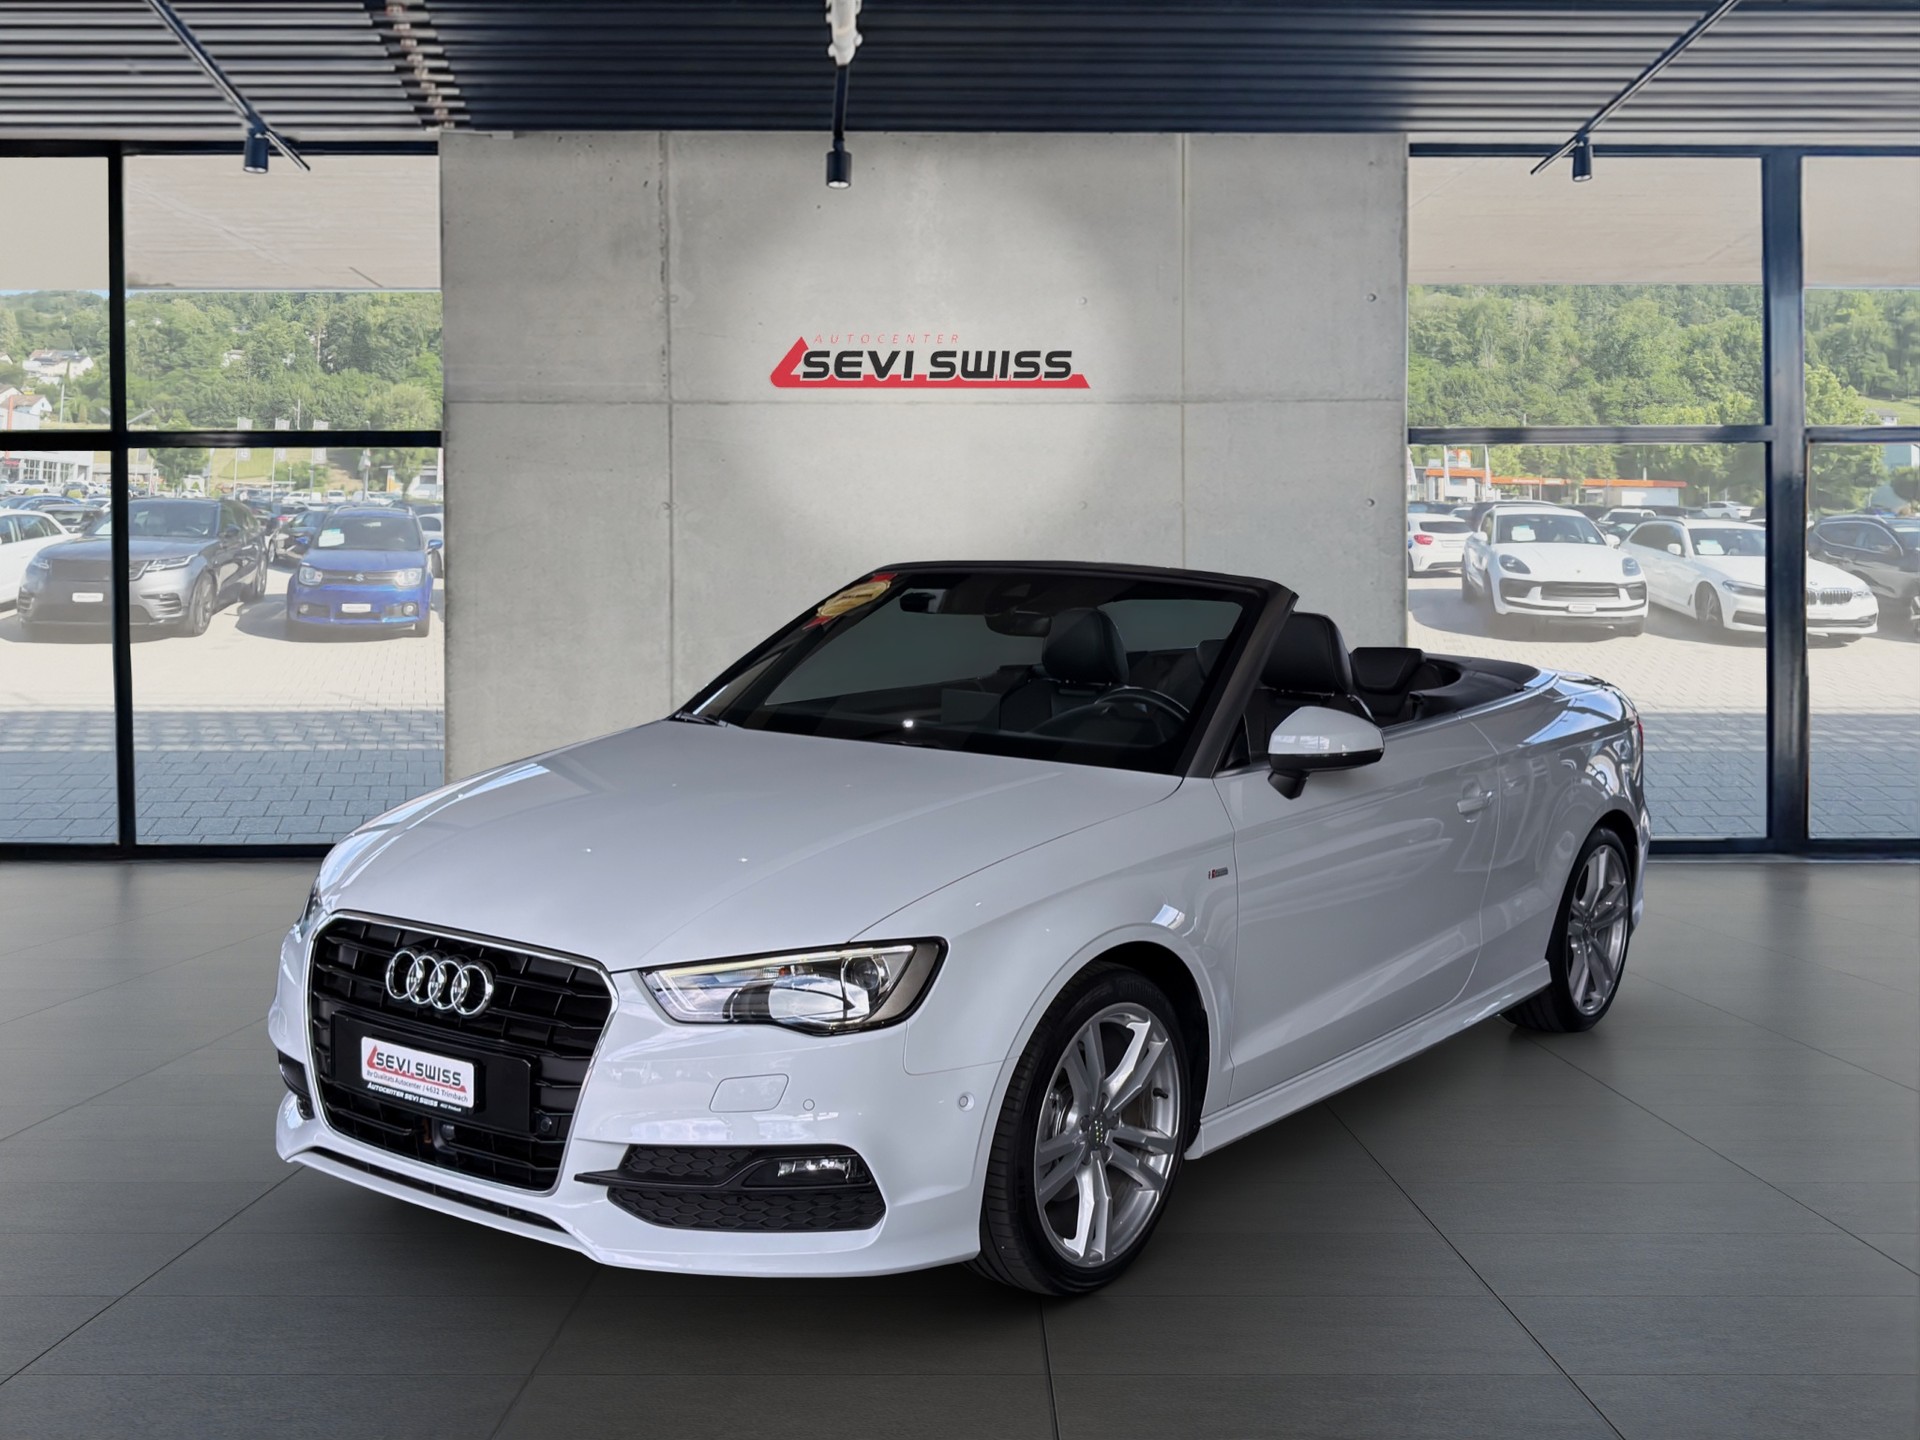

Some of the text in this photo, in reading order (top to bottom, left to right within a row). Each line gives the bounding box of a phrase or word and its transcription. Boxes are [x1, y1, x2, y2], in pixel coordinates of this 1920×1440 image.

[813, 333, 960, 345] AUTOCENTER
[802, 350, 1073, 379] SEVI SWISS
[375, 1052, 462, 1087] SEVI SWISS
